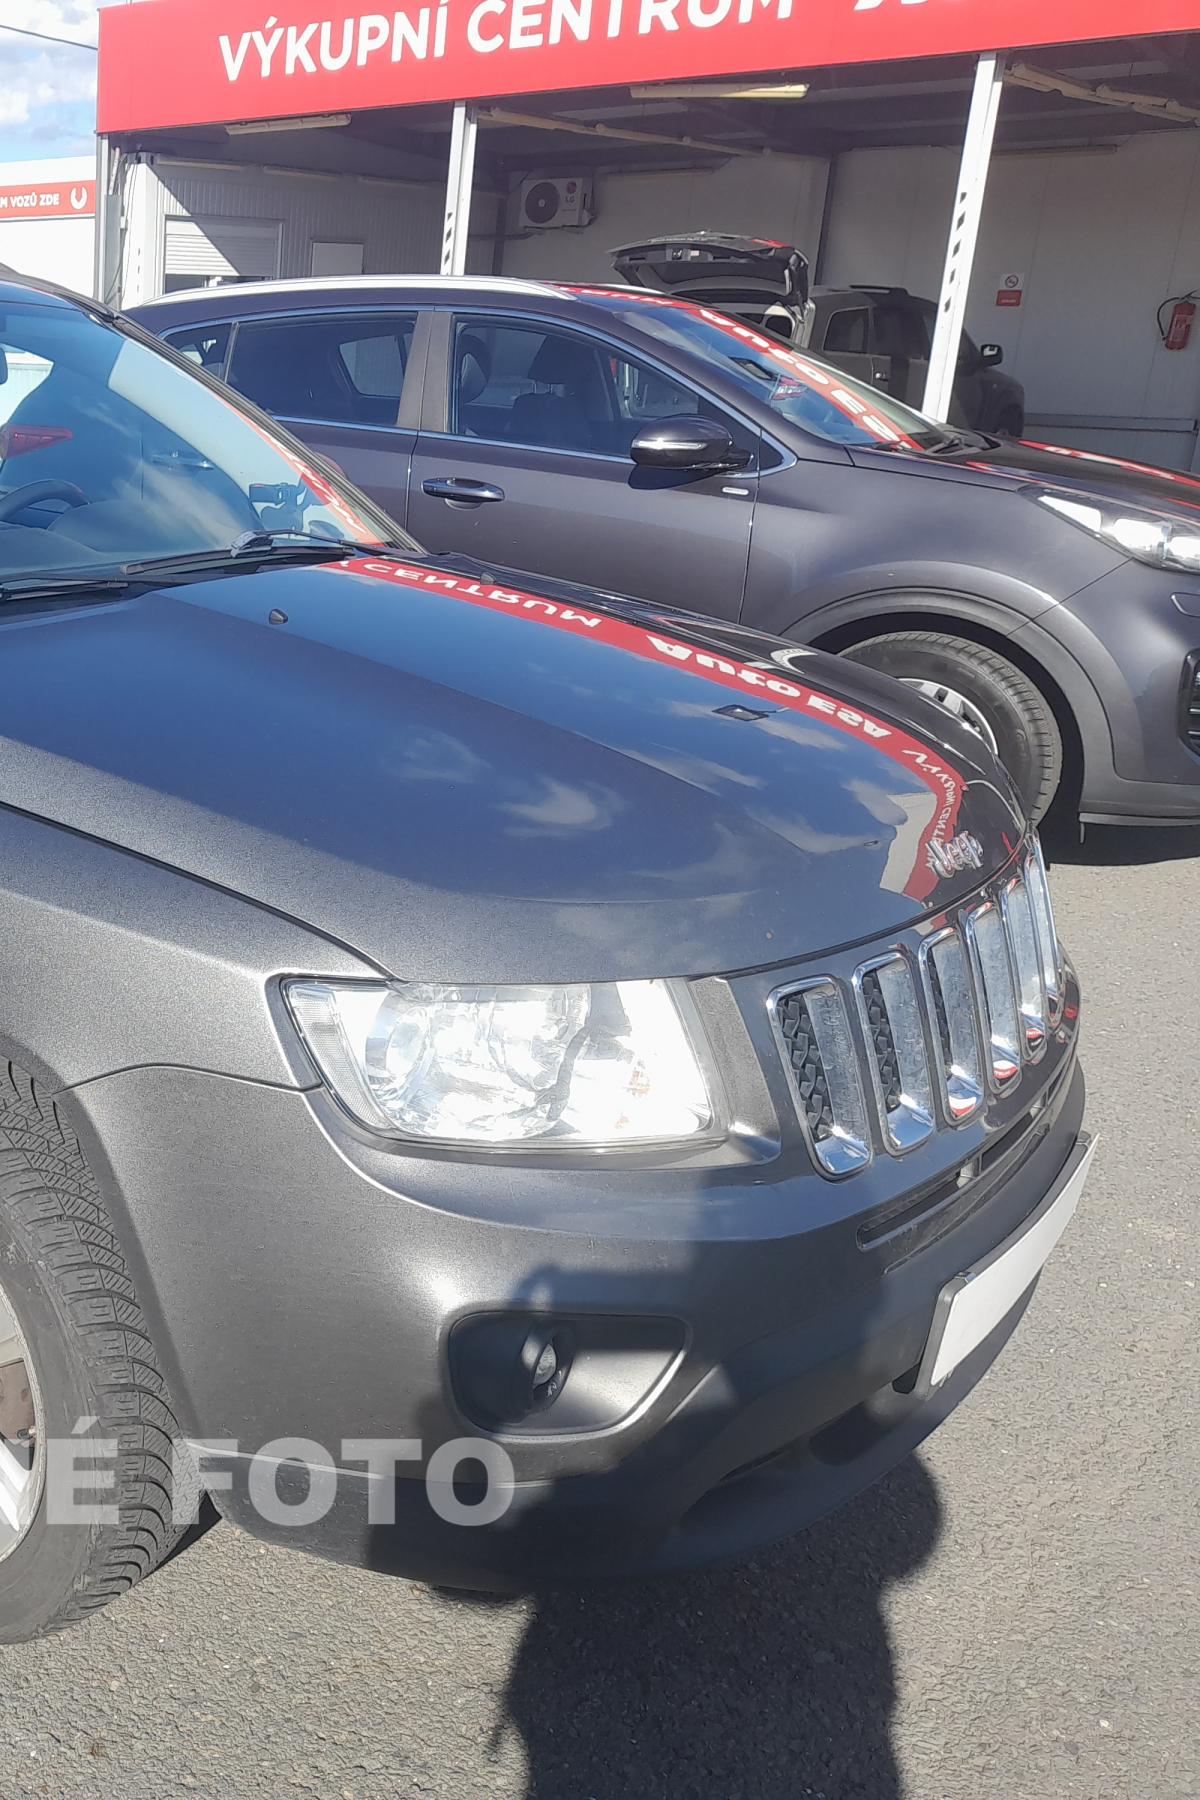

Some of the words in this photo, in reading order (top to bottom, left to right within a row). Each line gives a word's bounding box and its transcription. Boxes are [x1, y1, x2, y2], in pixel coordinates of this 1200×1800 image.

[219, 0, 448, 81] VÝKUPNÍ
[9, 192, 37, 208] VOZŮ
[39, 193, 60, 206] ZDE
